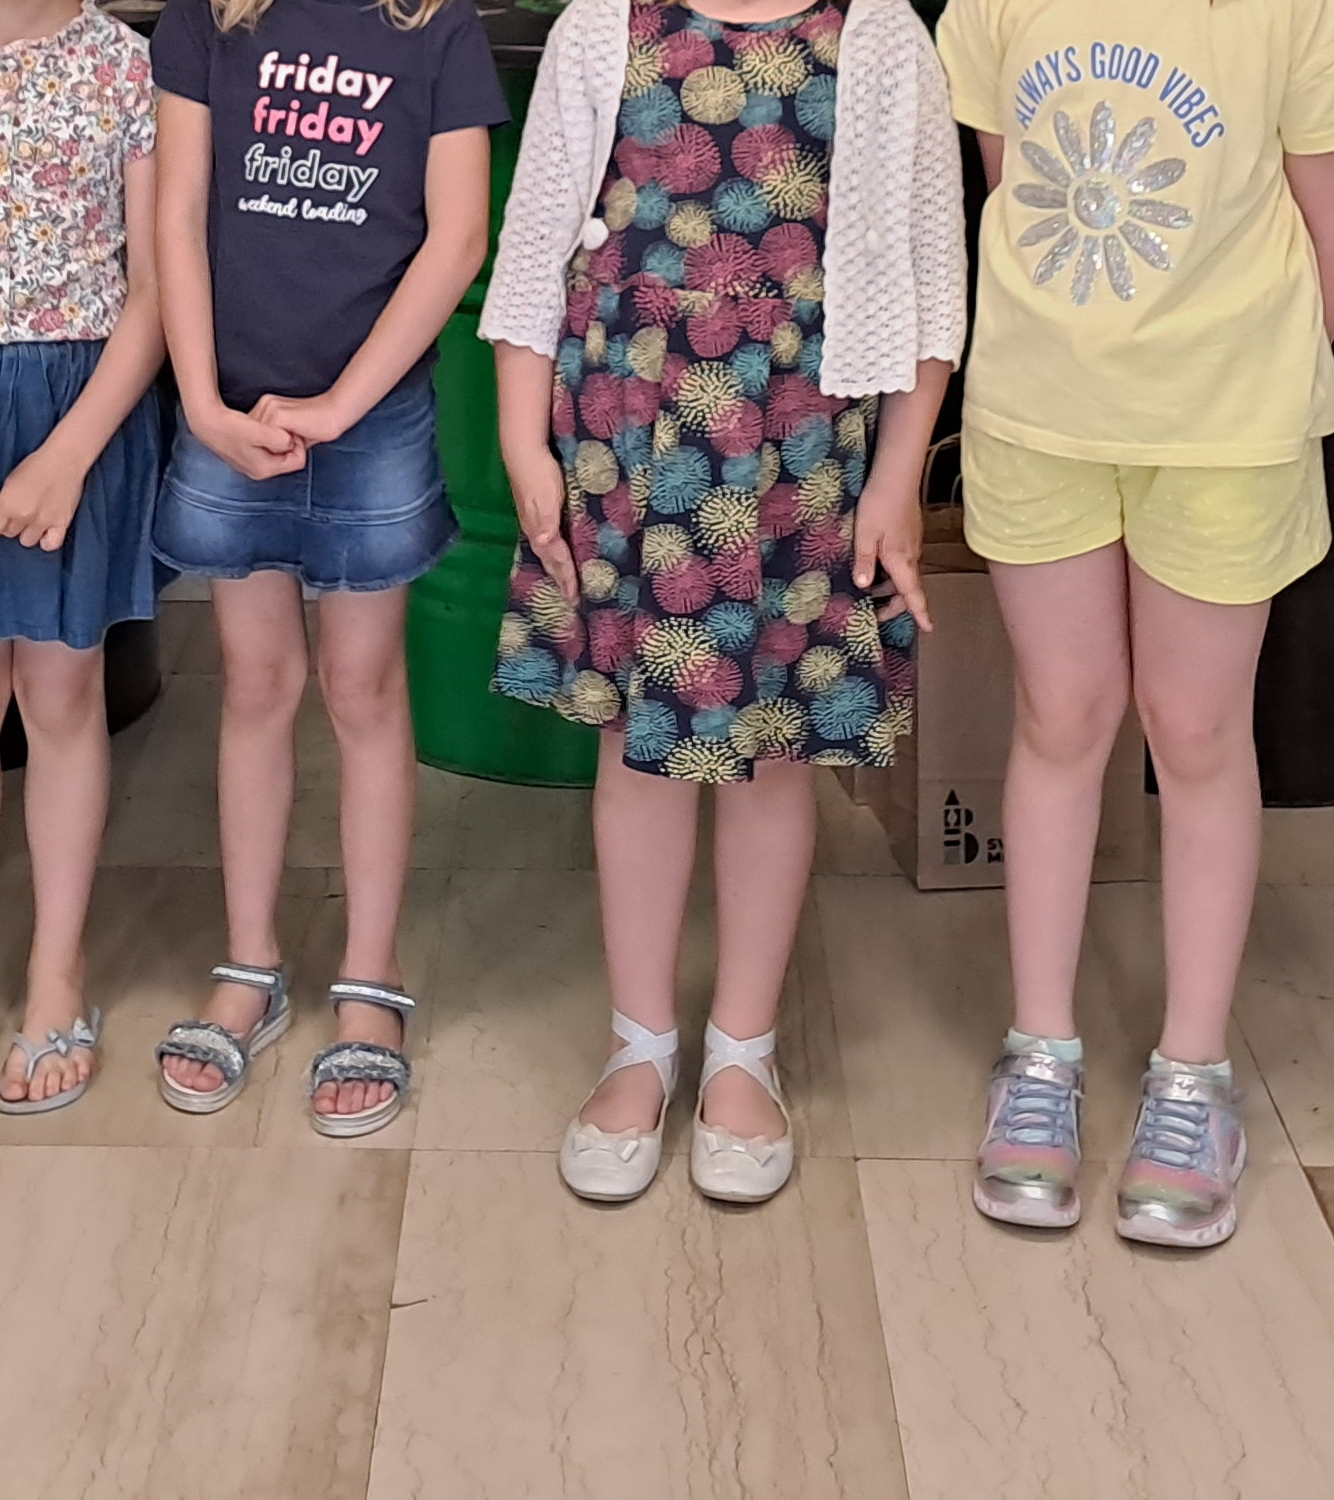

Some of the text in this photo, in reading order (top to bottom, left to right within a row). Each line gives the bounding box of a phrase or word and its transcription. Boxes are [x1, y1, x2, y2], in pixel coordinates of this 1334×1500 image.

[258, 50, 394, 111] friday
[1014, 42, 1225, 149] ALWAYS GOOD VIBES
[253, 96, 384, 156] friday
[244, 142, 379, 203] friday
[238, 194, 369, 227] weekend loading
